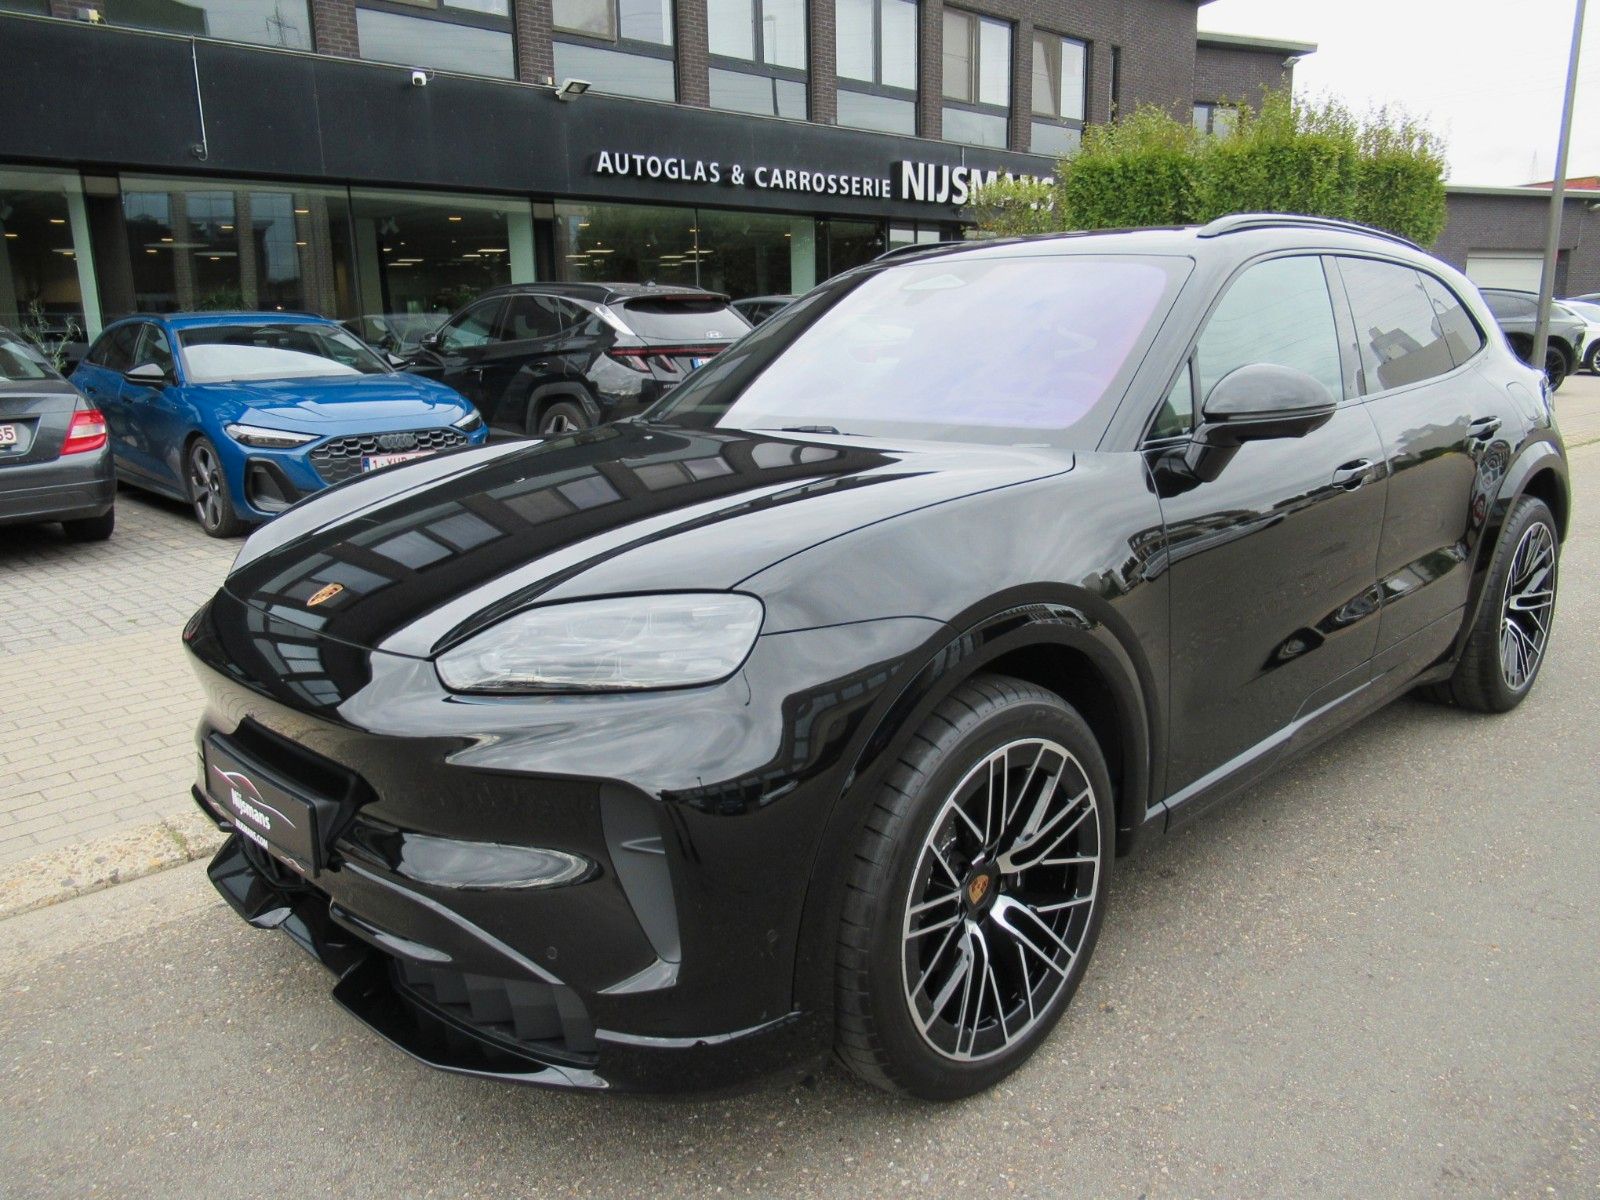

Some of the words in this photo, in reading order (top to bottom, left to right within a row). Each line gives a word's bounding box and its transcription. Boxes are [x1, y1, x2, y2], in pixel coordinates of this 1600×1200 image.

[596, 150, 720, 183] AUTOGLAS
[731, 164, 745, 185] &
[754, 166, 891, 198] CARROSSERIE
[0, 427, 14, 441] 5
